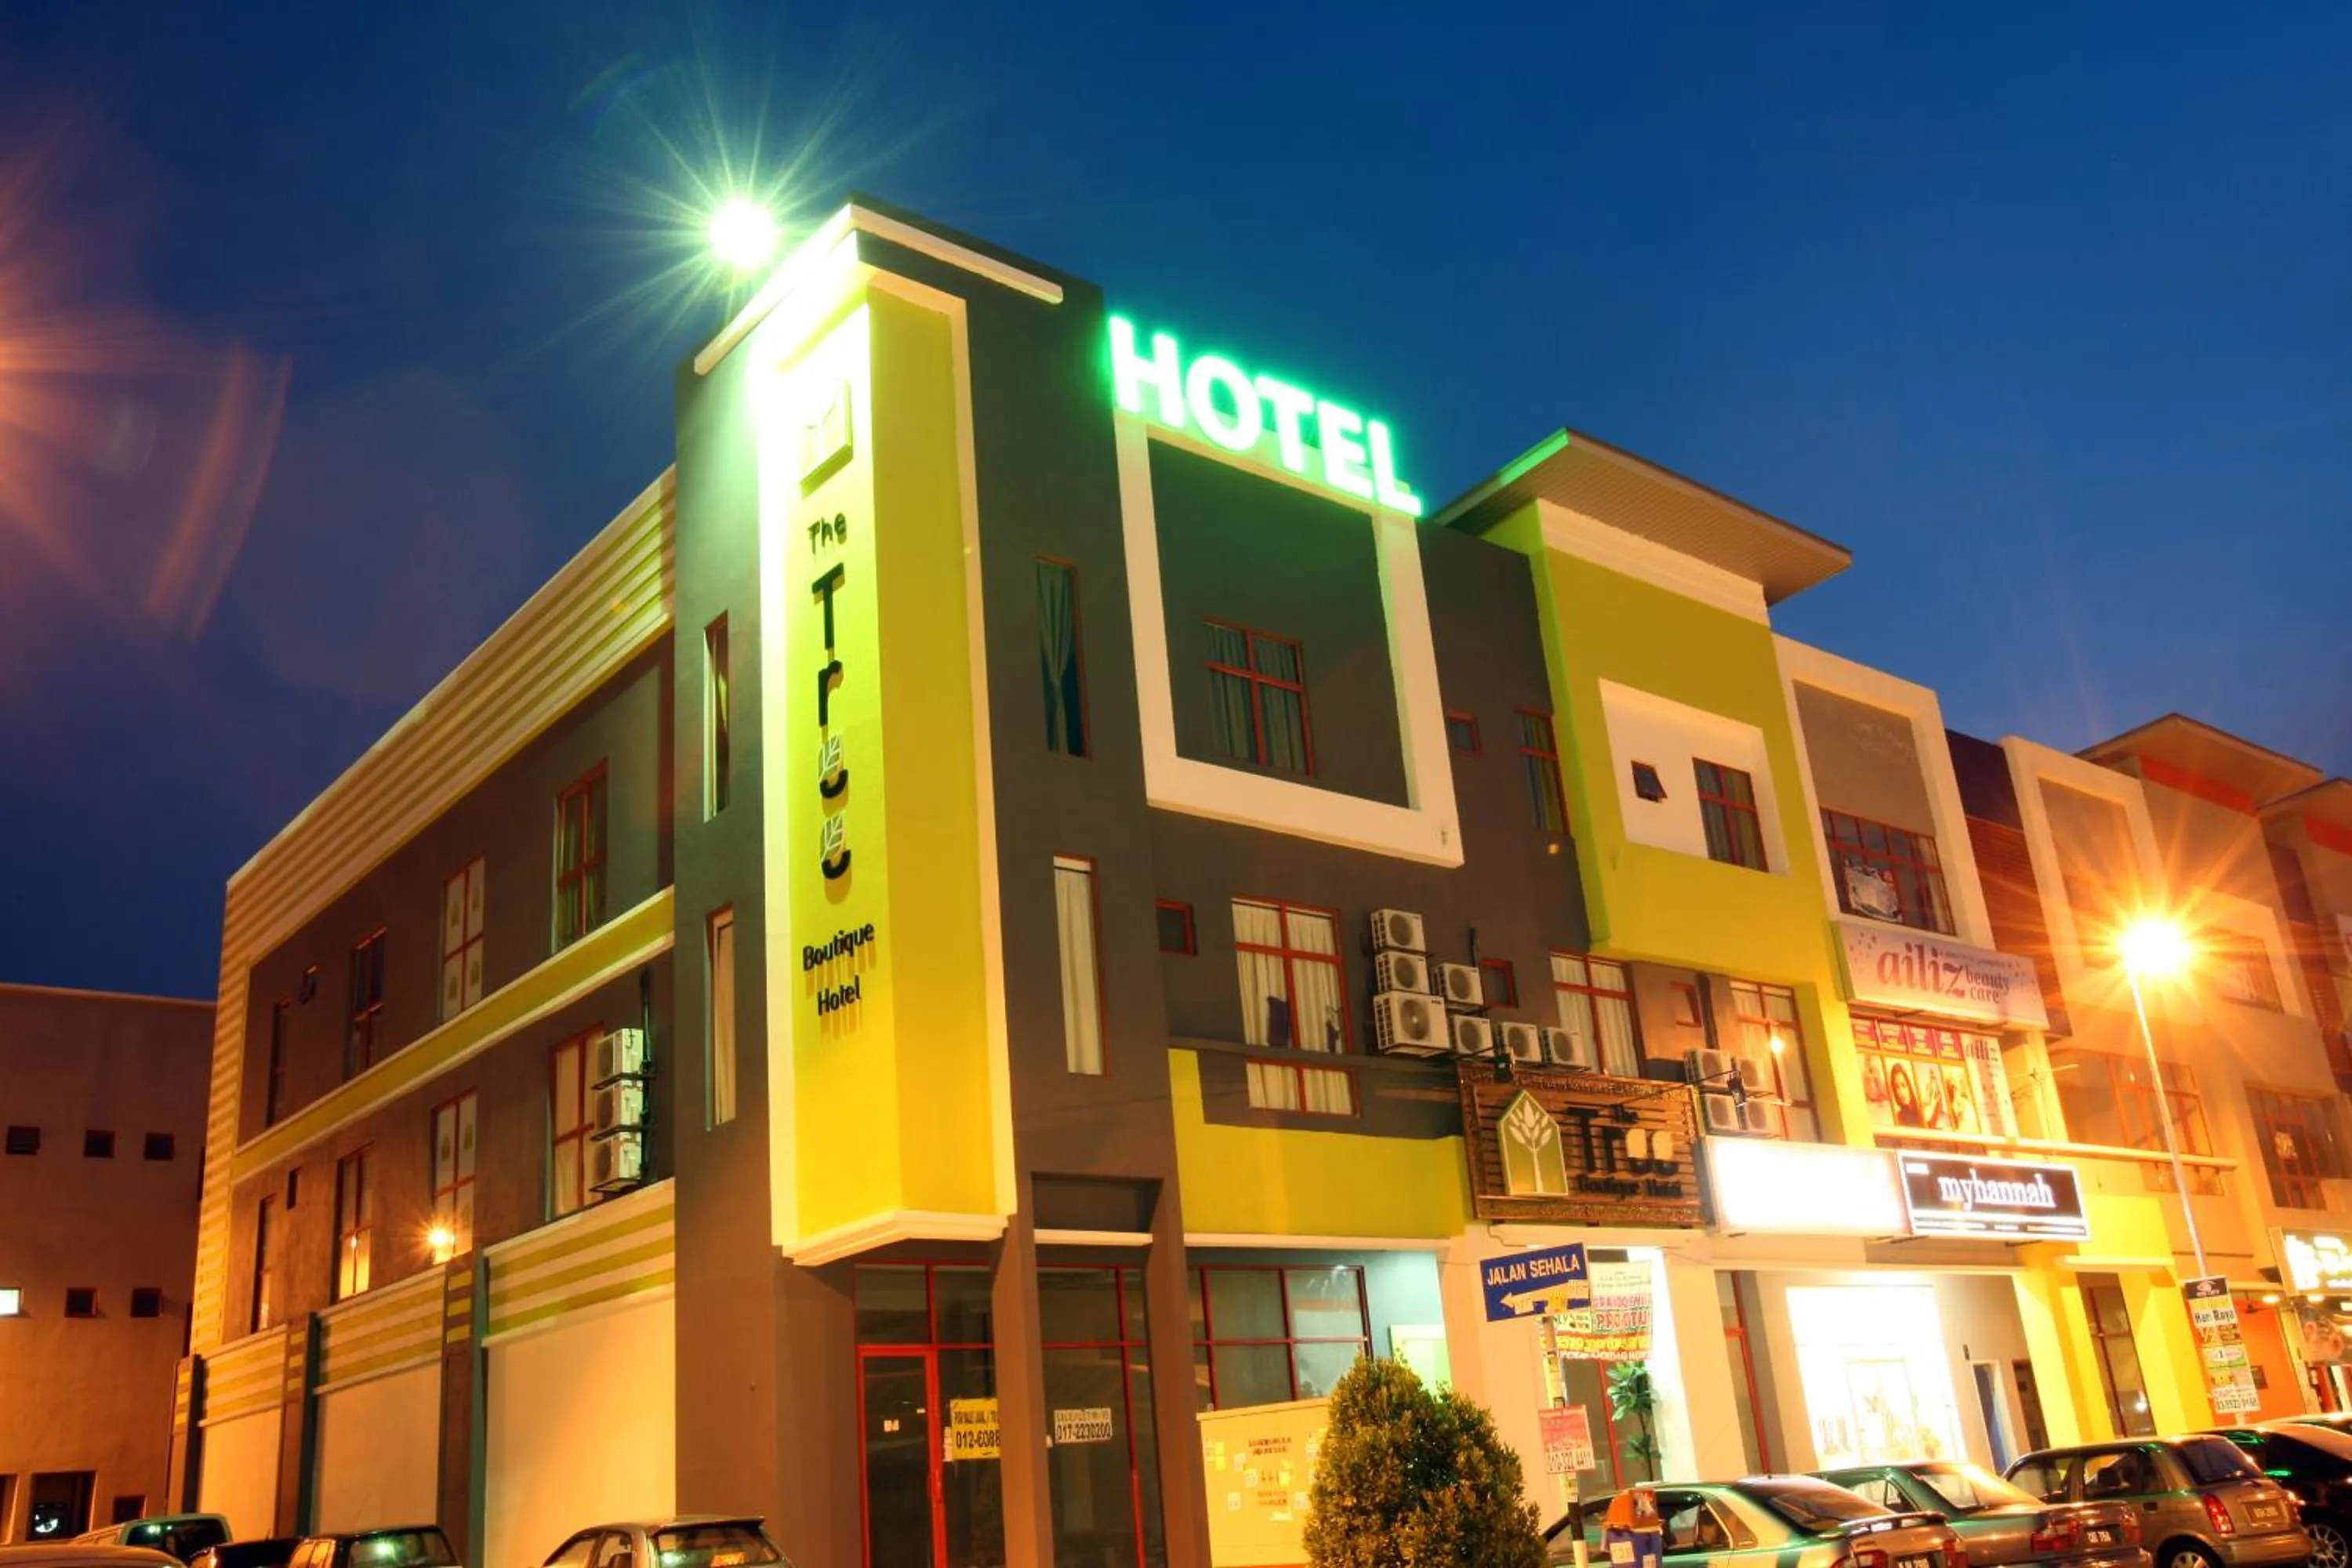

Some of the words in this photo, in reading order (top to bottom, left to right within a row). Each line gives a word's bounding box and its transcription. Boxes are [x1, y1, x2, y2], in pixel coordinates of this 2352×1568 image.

[1109, 314, 1422, 517] HOTEL
[808, 512, 848, 546] The
[803, 924, 875, 971] Boutique
[1877, 942, 1966, 998] ailiz
[1965, 965, 2010, 996] beauty
[818, 975, 862, 1016] Hotel
[1970, 986, 1999, 1004] care
[1937, 1168, 2056, 1211] myhannah
[1487, 1263, 1526, 1286] JALAN
[1530, 1254, 1581, 1278] SEHALA
